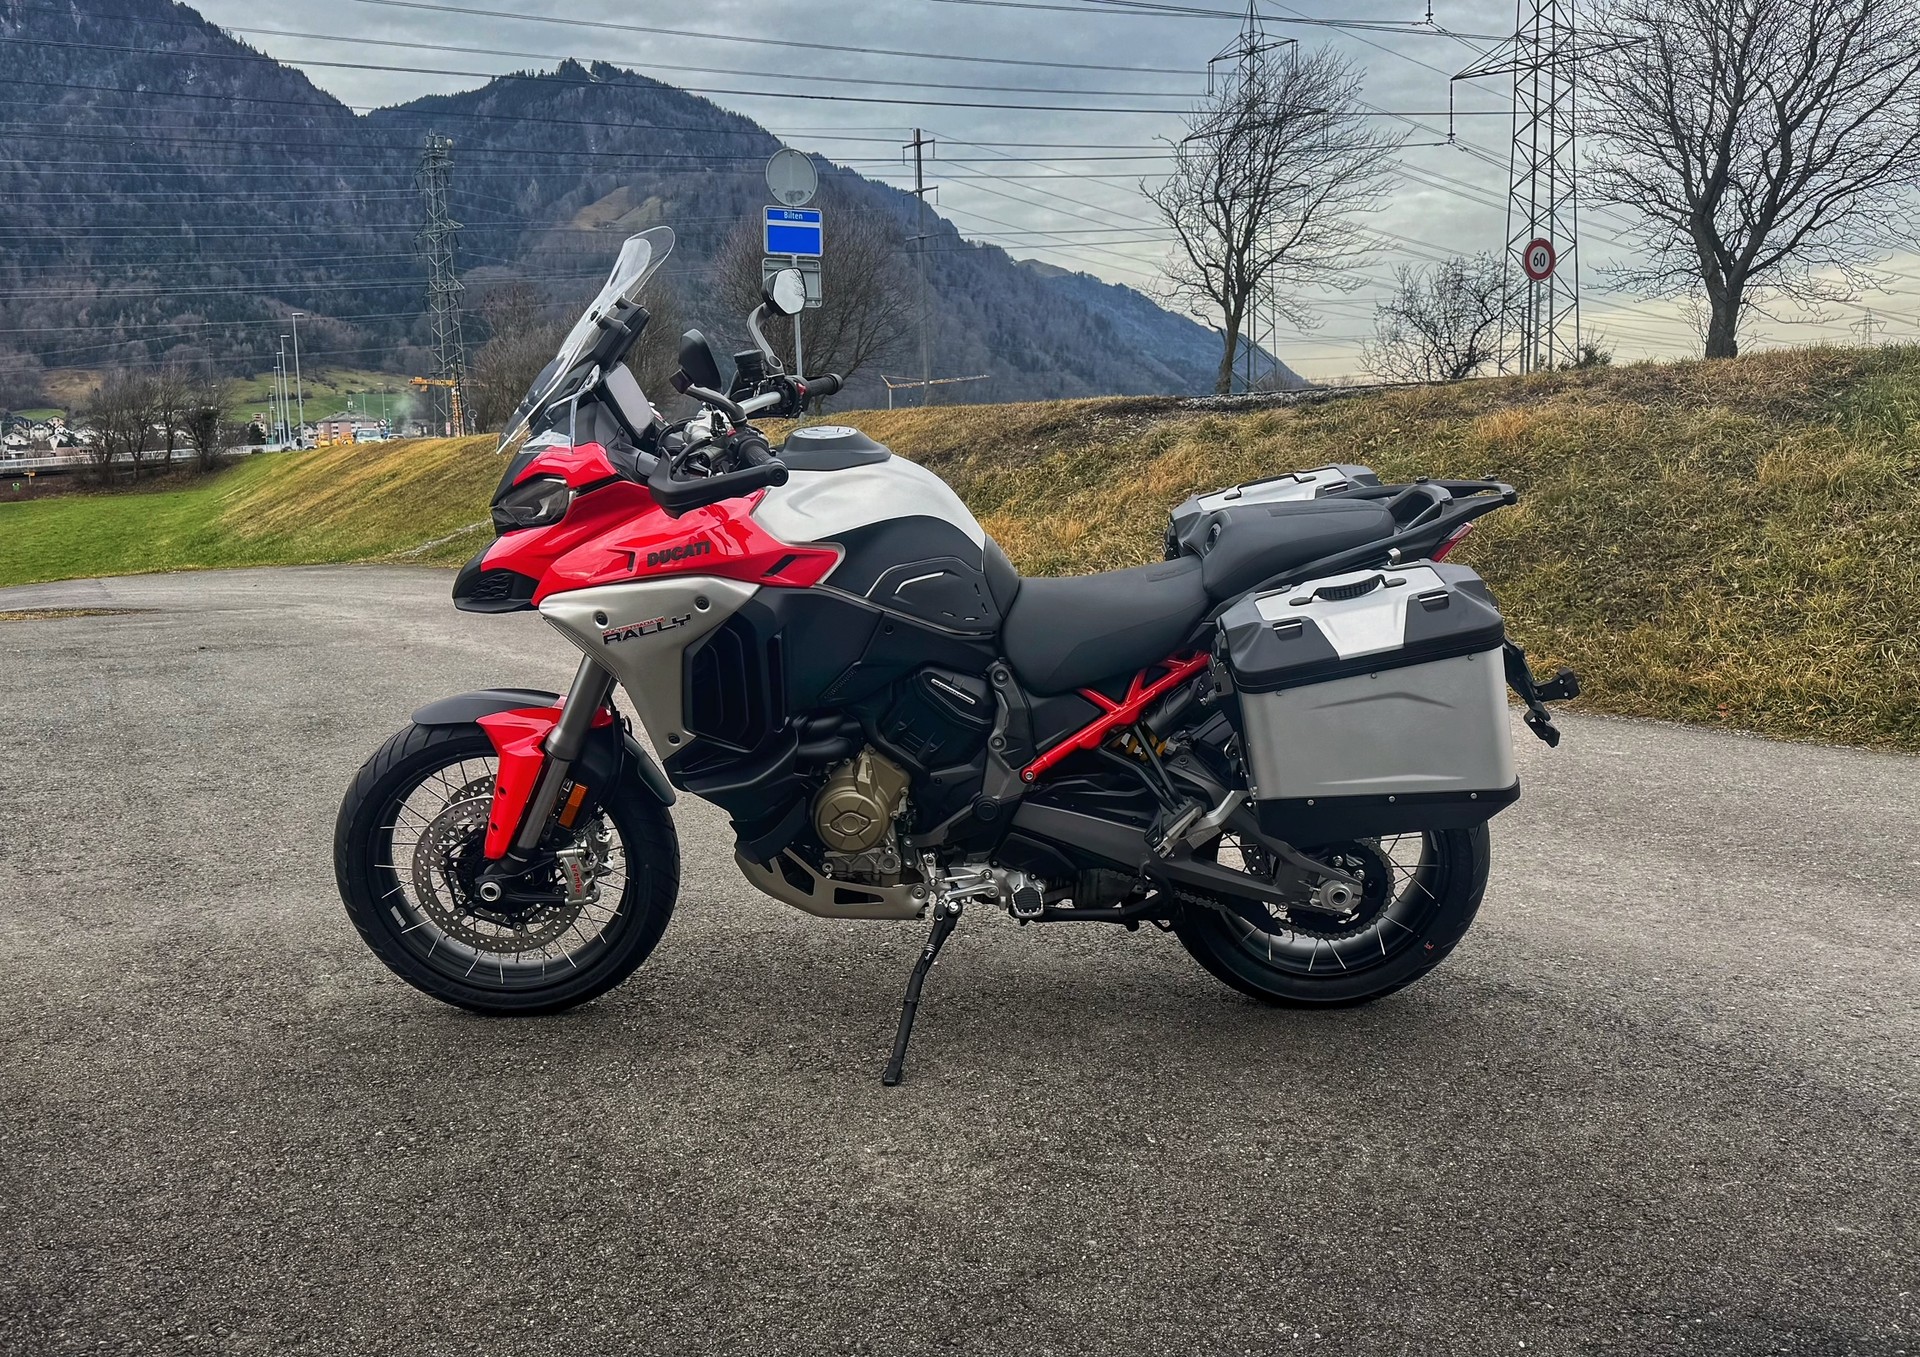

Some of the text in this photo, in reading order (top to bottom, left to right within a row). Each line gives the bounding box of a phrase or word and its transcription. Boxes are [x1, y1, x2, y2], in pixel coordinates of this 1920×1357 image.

[1533, 252, 1546, 267] 60
[647, 540, 711, 567] DUCATI
[603, 614, 691, 645] RALLY
[571, 863, 582, 893] brembo
